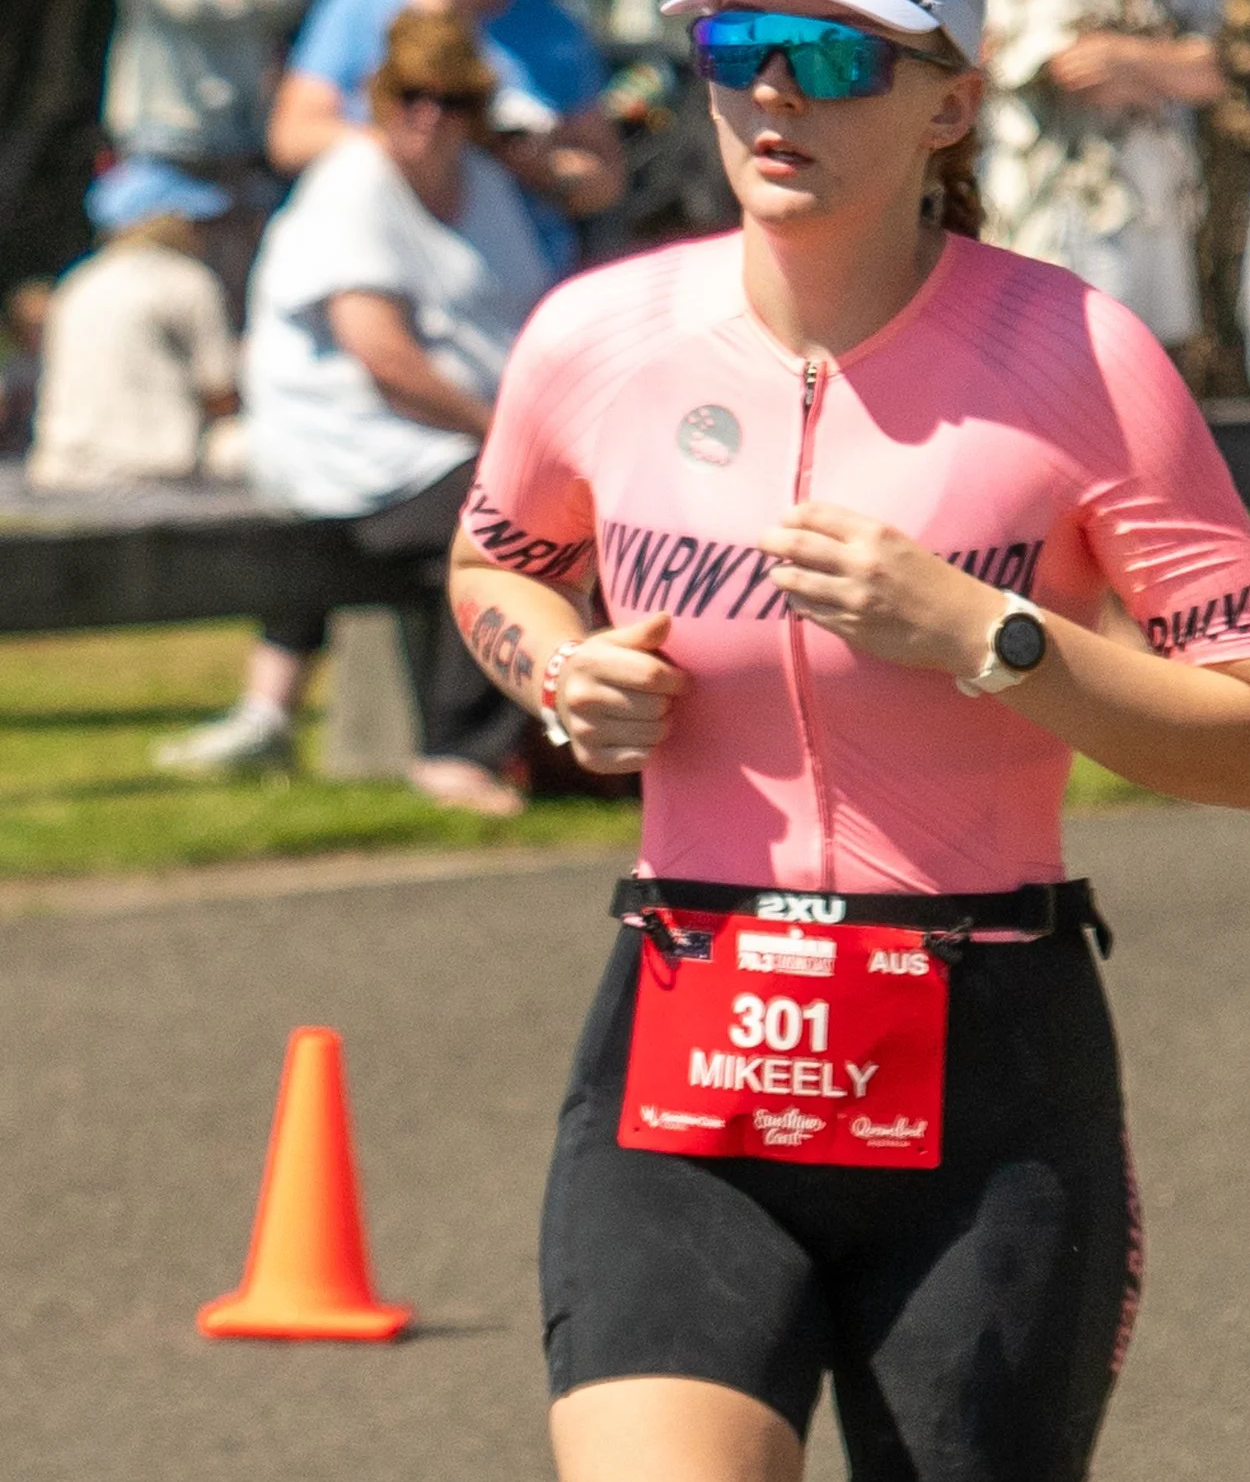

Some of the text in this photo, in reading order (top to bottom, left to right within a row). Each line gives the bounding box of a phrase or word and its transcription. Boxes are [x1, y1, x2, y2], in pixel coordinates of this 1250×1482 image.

[757, 894, 847, 924] 2XU
[867, 949, 931, 976] AUS
[729, 992, 830, 1053] 301
[689, 1048, 879, 1099] MIKEELY
